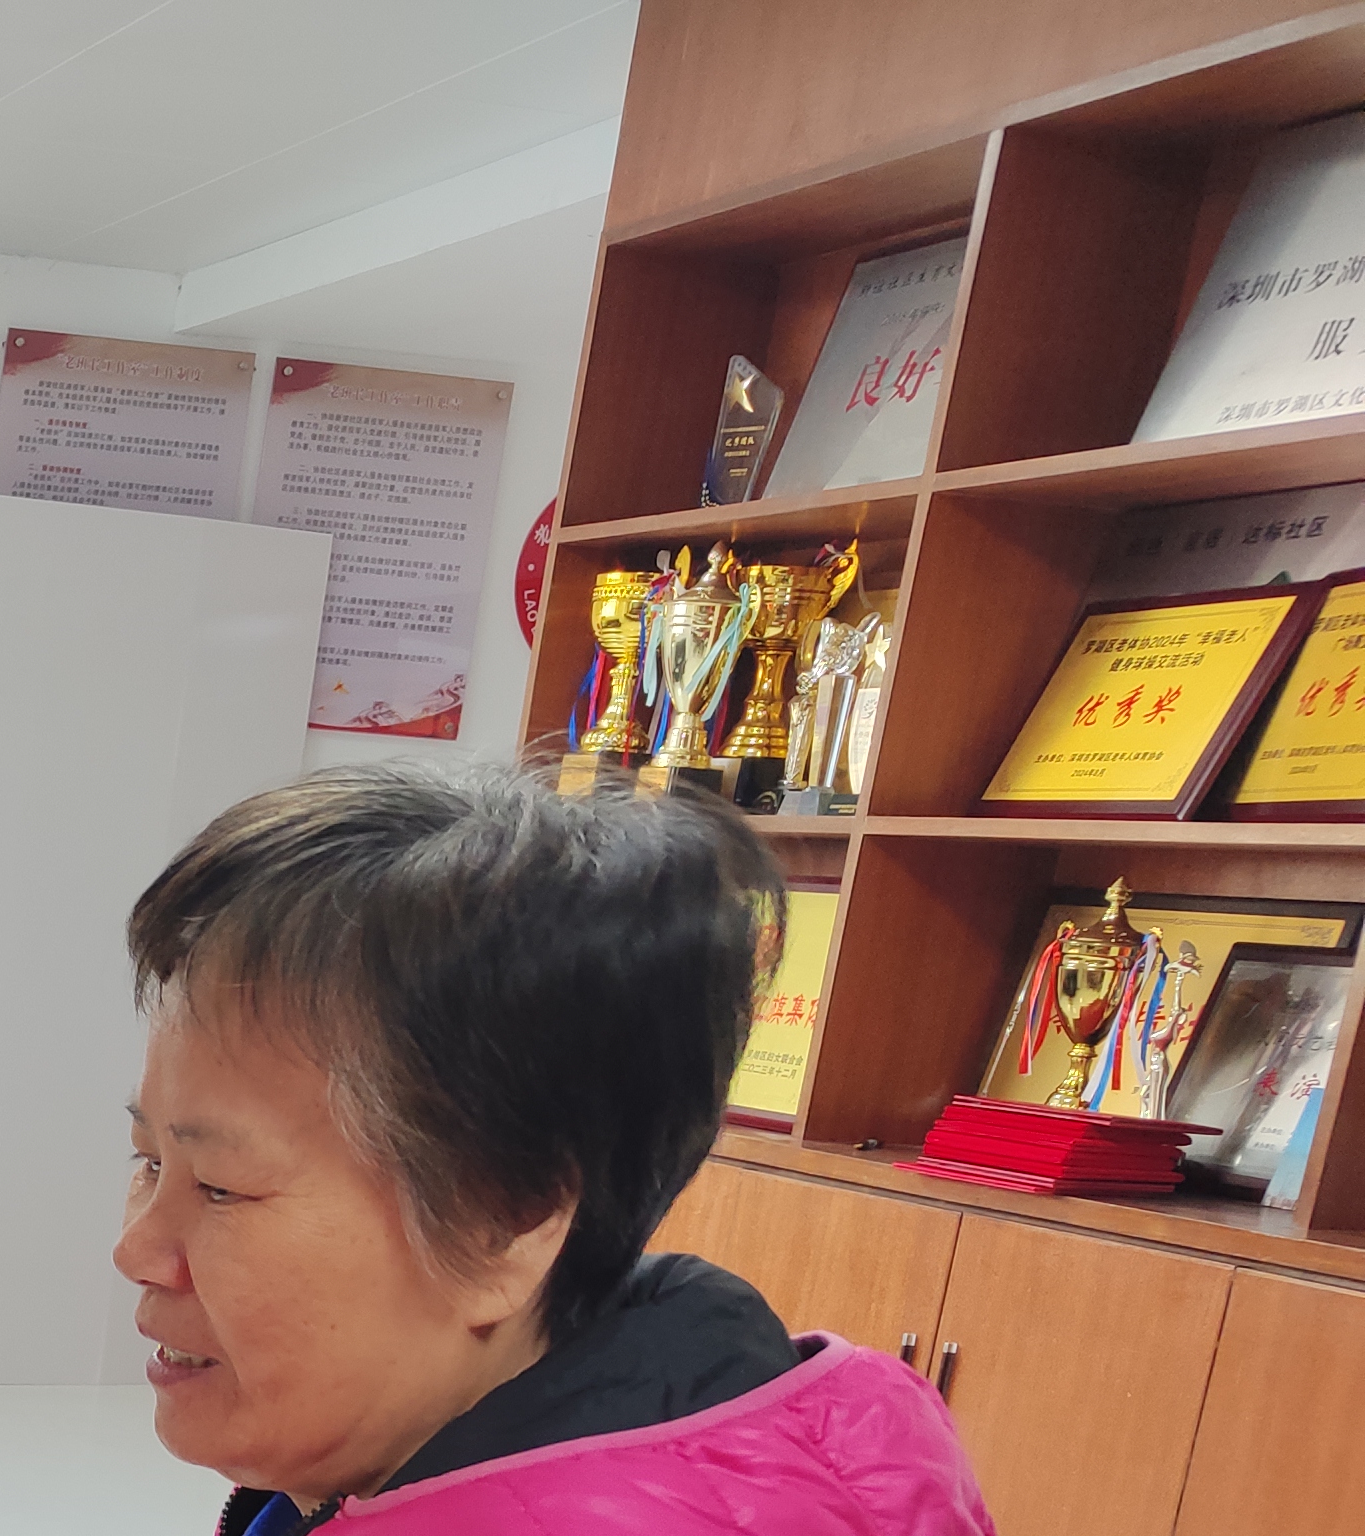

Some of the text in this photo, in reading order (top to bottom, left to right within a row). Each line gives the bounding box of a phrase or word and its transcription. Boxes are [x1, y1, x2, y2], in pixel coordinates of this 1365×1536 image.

[1072, 683, 1183, 728] 优秀奖
[1295, 665, 1365, 718] 优秀
